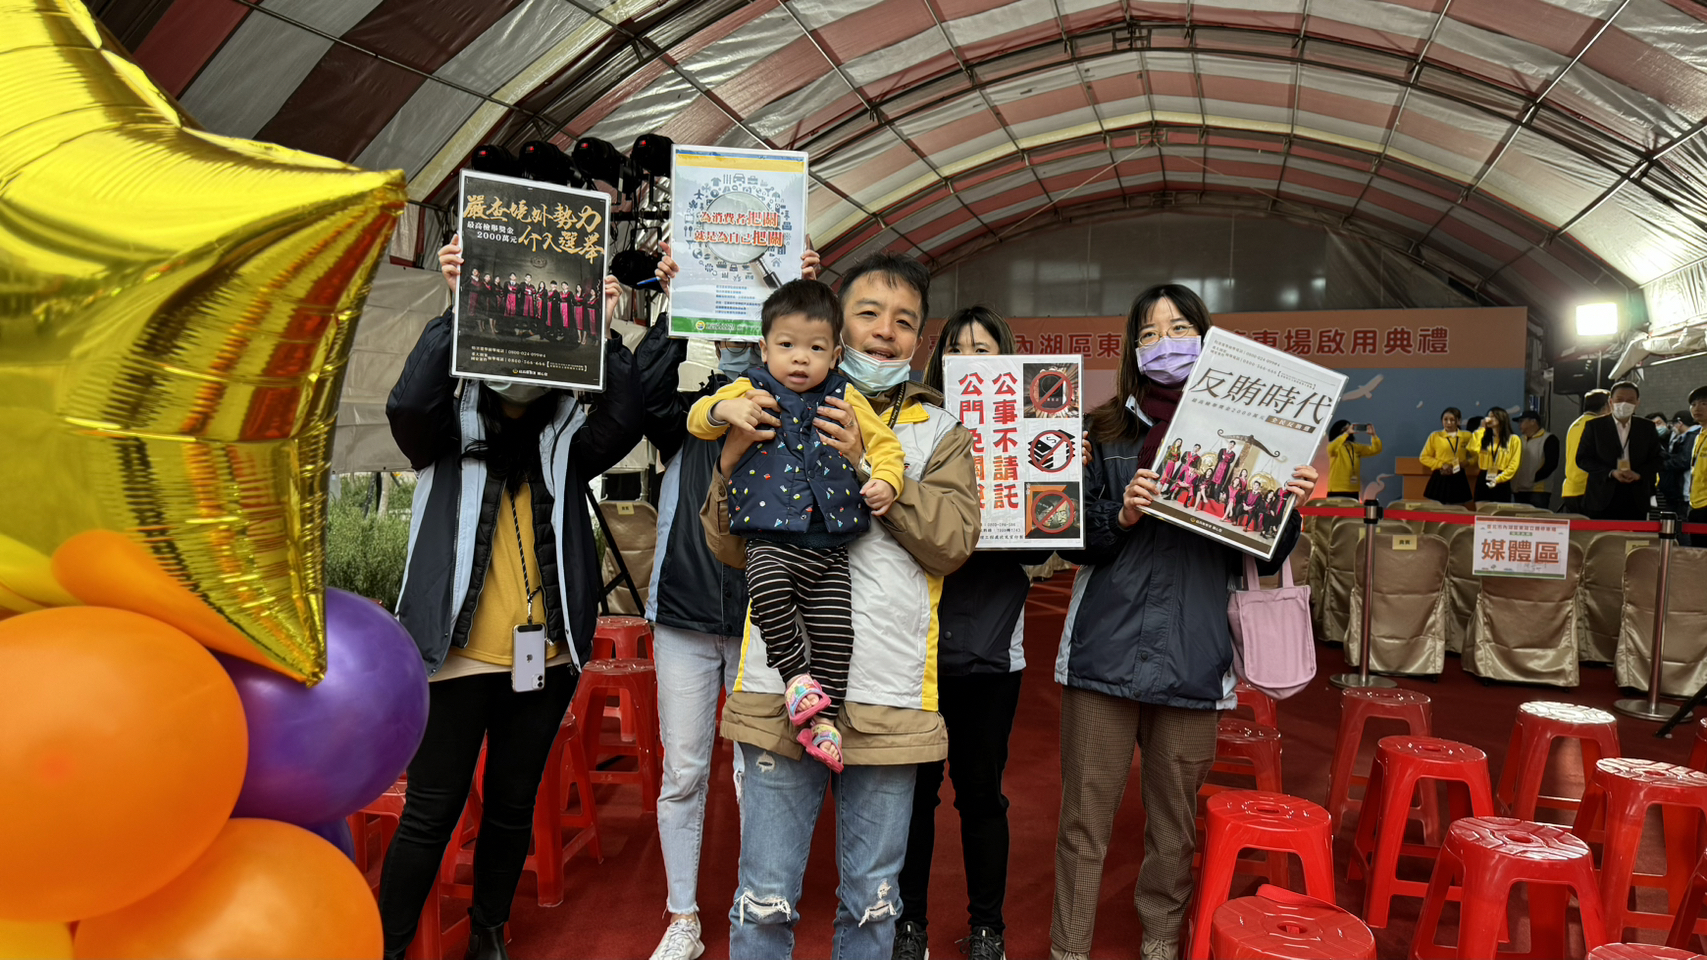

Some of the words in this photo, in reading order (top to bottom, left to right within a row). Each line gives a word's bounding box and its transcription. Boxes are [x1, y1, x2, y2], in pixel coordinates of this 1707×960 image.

[463, 195, 602, 233] 嚴查境外勢力
[700, 211, 779, 227] 為消費者把關
[477, 231, 518, 244] 2000萬元
[518, 225, 605, 264] 介入選舉
[694, 230, 784, 247] 就是為自己把關
[1234, 327, 1450, 356] 車場啟用典禮
[1189, 367, 1332, 425] 反賄時代
[992, 372, 1020, 509] 公事不請託
[1481, 538, 1560, 564] 媒體區
